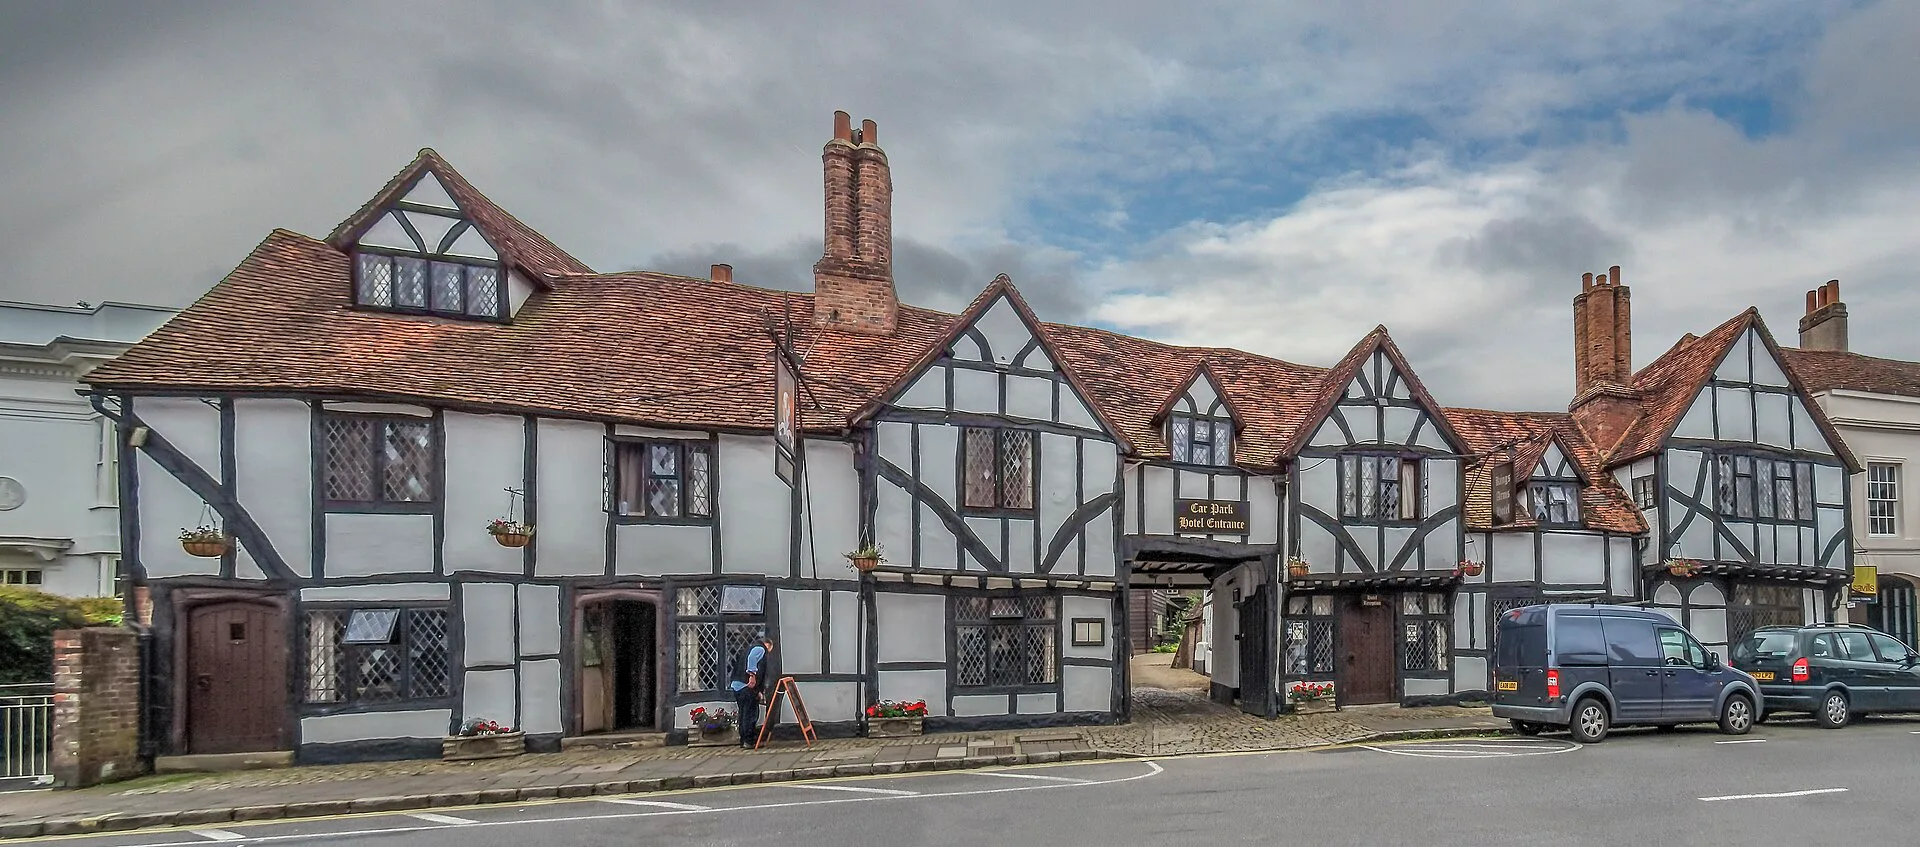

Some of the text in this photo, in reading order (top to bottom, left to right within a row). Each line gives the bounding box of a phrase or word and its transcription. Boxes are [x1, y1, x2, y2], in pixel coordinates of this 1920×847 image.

[1190, 502, 1234, 515] Car Park
[1179, 516, 1245, 529] Hotel Entrance
[1852, 583, 1875, 592] savills
